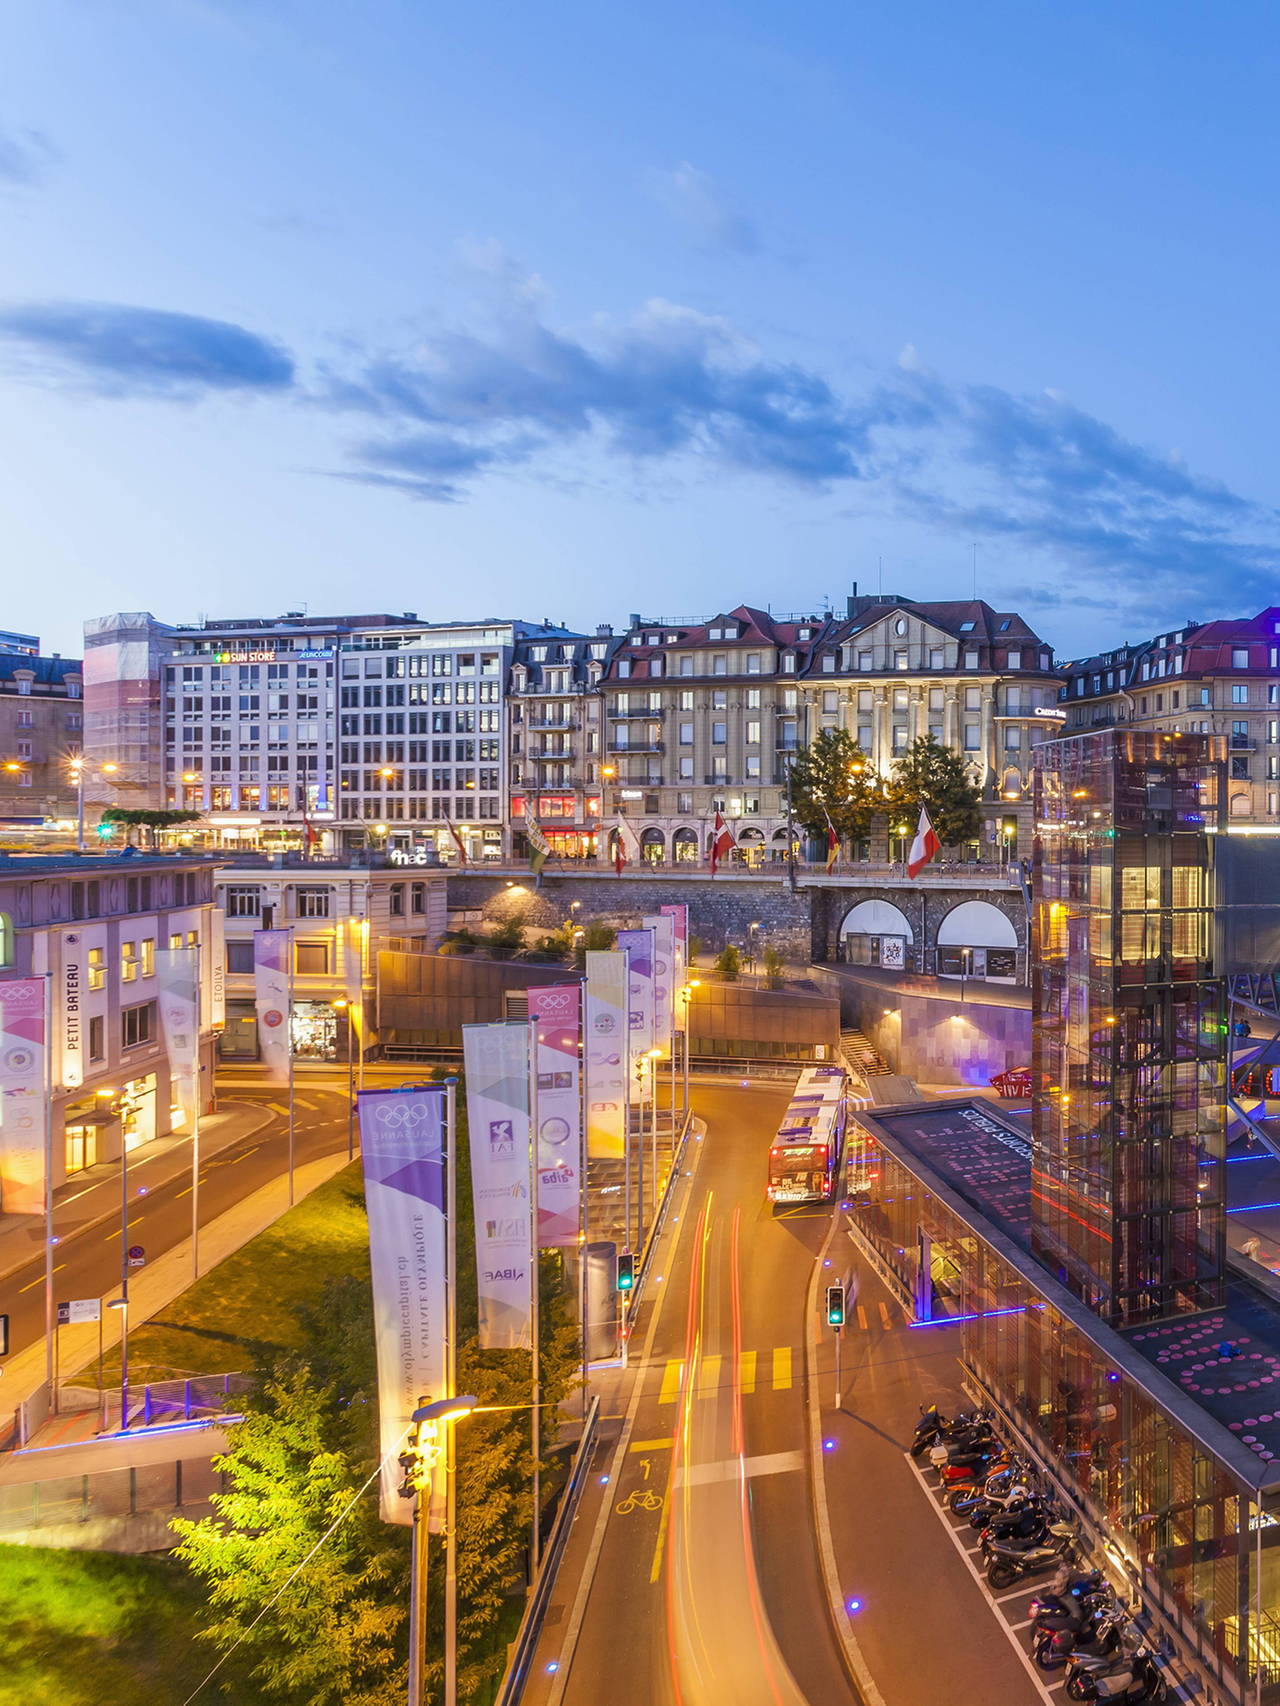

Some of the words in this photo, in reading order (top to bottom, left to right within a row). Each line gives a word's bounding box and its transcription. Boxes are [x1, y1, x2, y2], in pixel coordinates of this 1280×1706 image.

[230, 653, 247, 663] SUN
[249, 652, 276, 662] STORE
[390, 849, 428, 865] fnac
[66, 963, 79, 1011] BATEAU
[214, 965, 223, 1002] ETOILYA
[67, 1016, 79, 1050] PETIT
